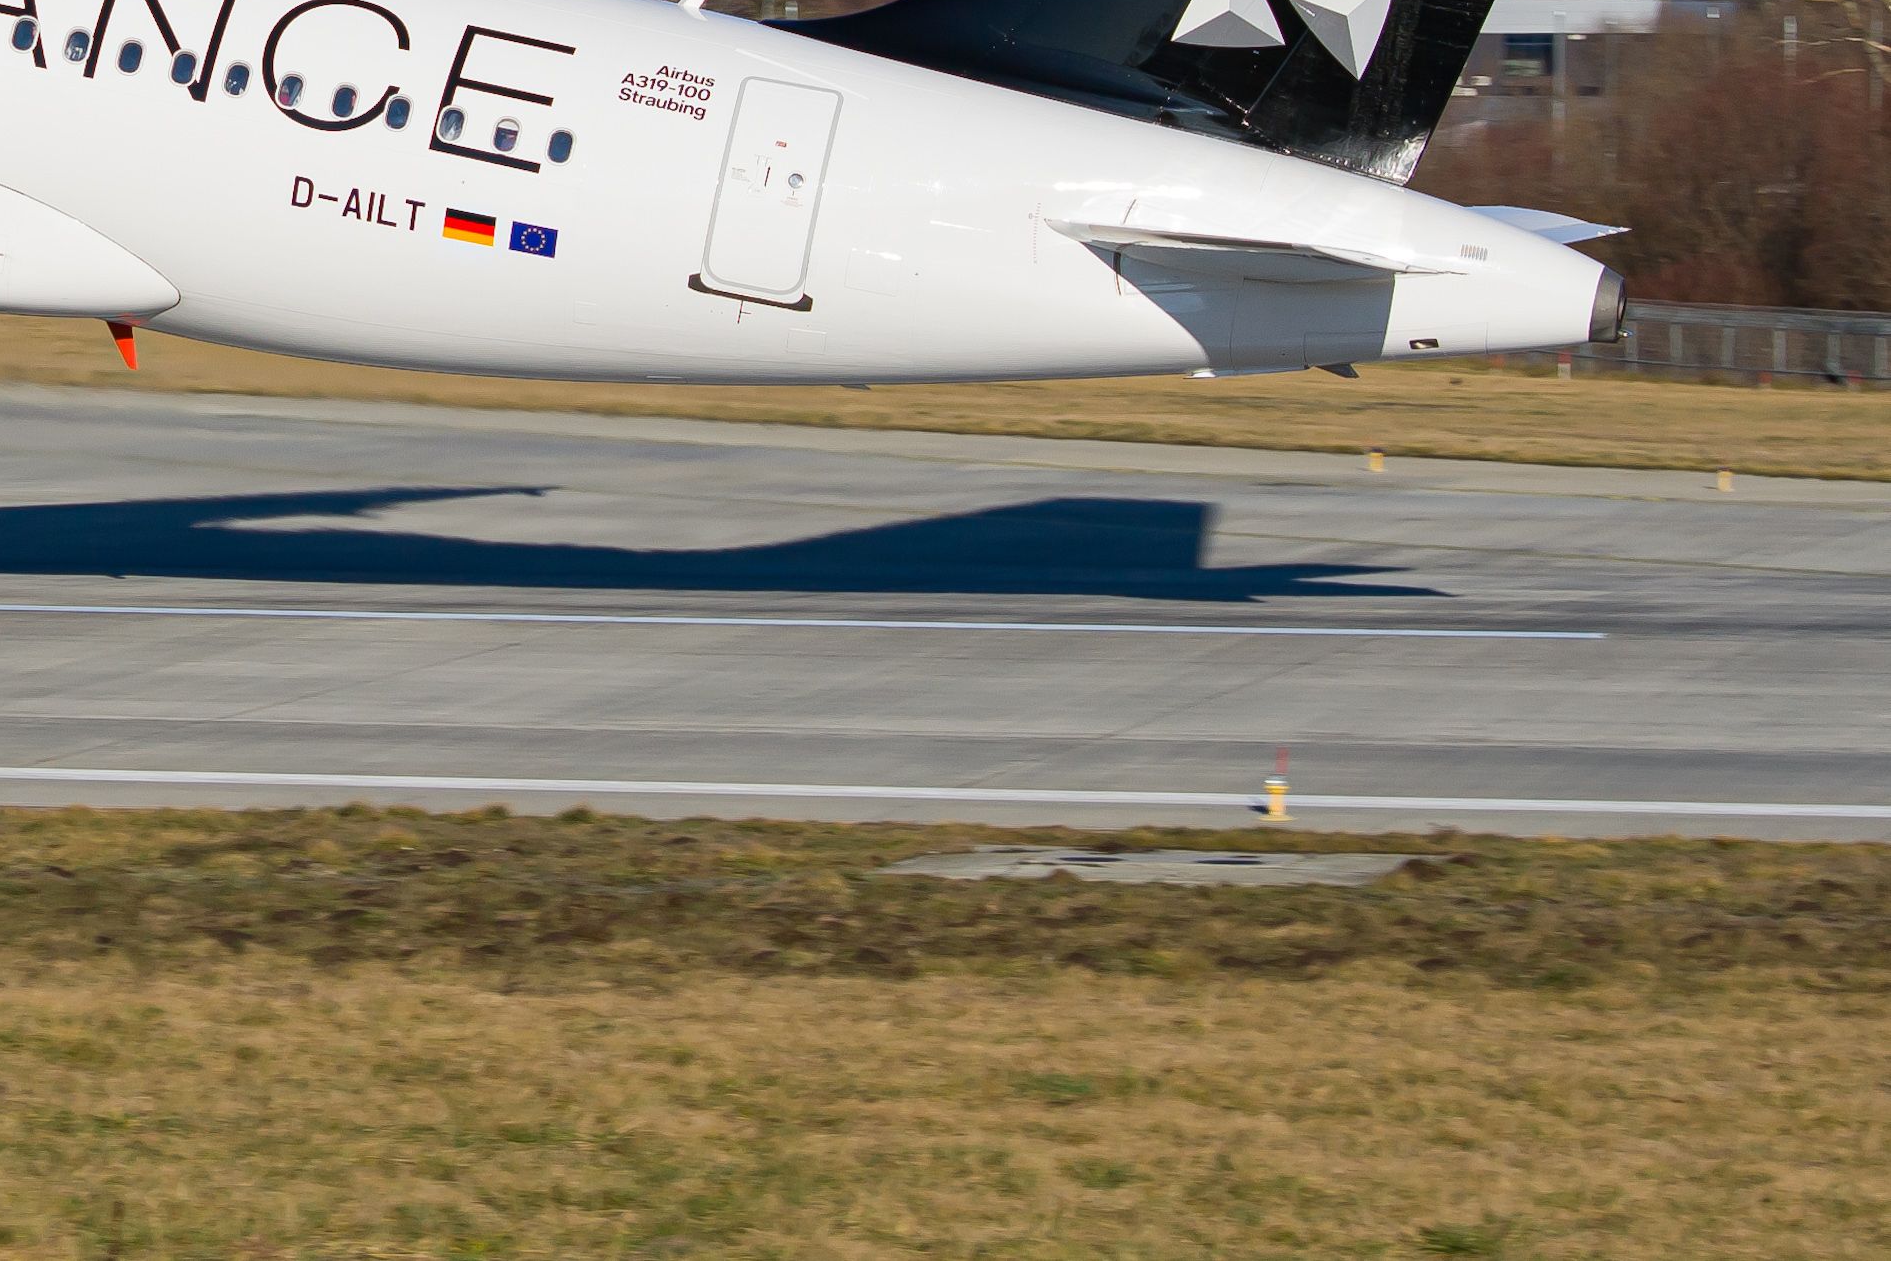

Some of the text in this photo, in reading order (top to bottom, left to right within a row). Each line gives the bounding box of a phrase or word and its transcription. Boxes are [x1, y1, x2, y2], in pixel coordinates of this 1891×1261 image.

[621, 73, 711, 101] A319-100
[655, 65, 716, 87] Airbus
[618, 87, 706, 121] Straubing
[291, 175, 426, 231] D-AILT
